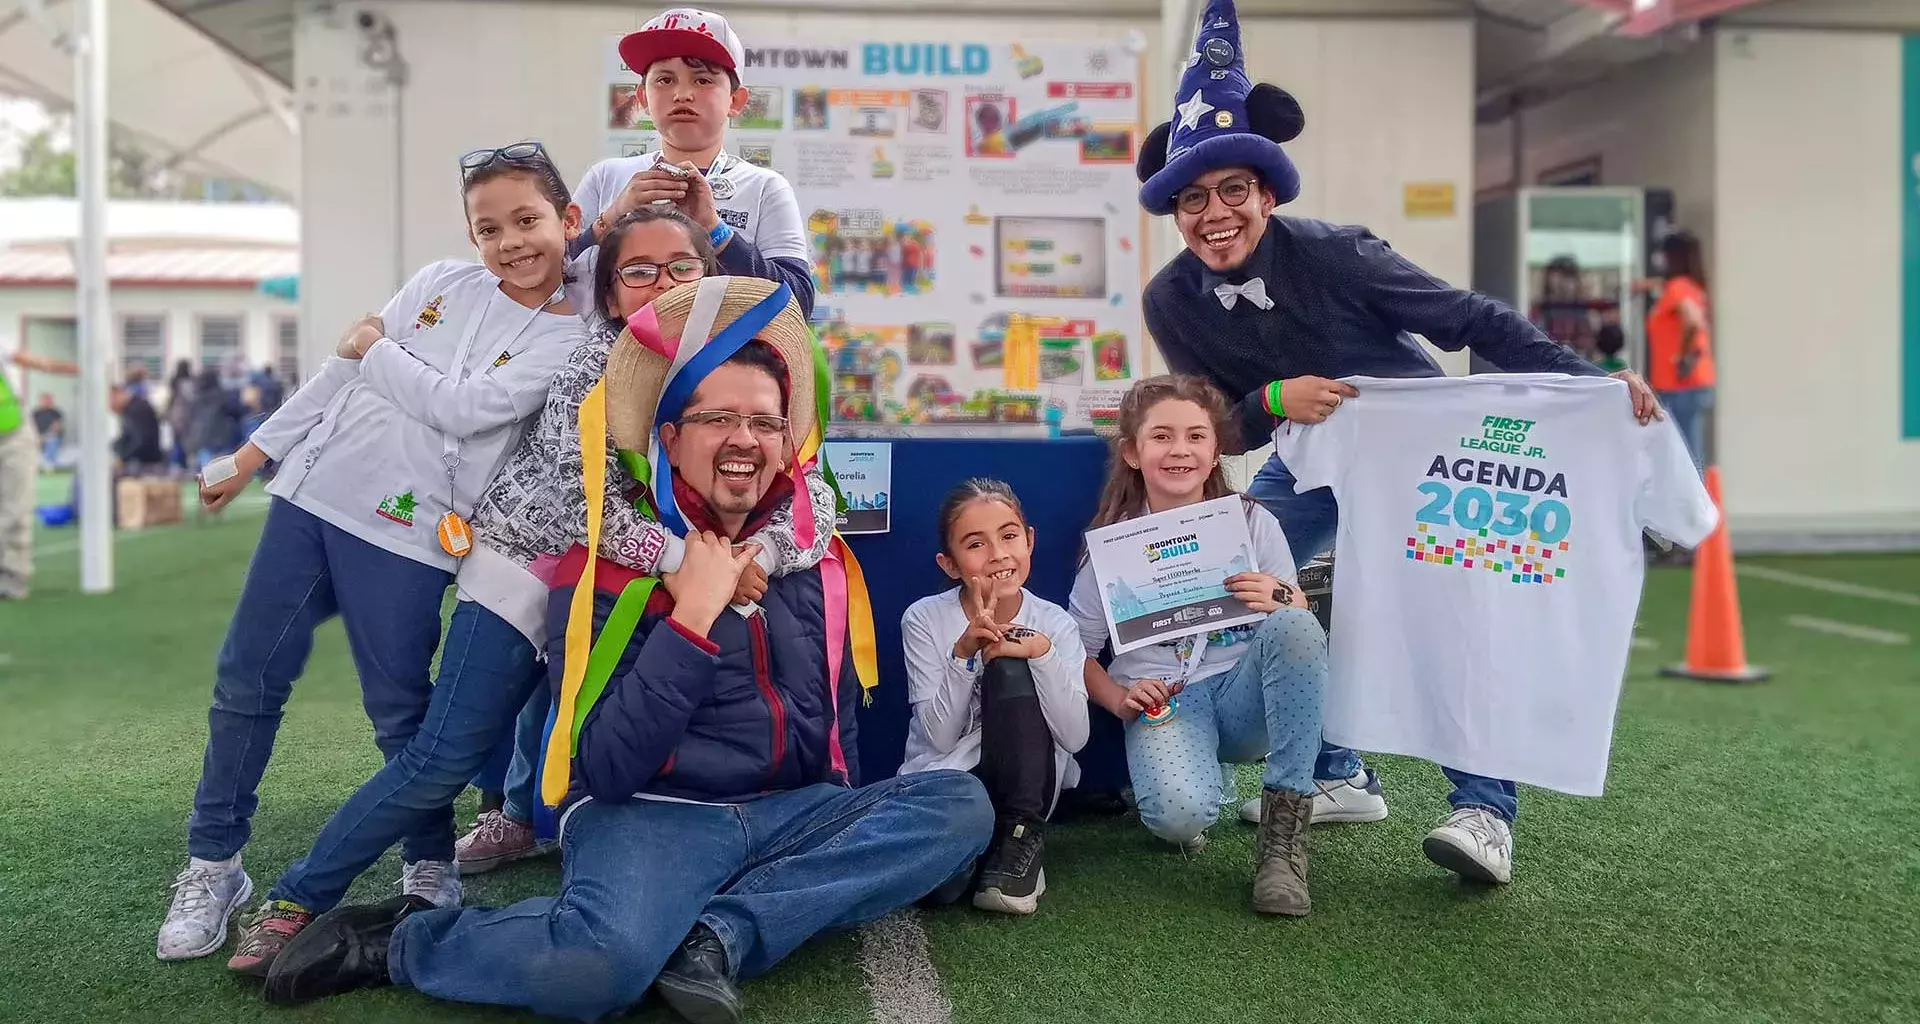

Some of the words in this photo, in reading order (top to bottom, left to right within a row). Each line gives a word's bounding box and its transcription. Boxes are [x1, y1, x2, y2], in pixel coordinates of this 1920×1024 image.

[744, 48, 849, 68] MTOWN
[862, 44, 989, 75] BUILD
[1482, 416, 1536, 432] FIRST
[1484, 428, 1526, 443] LEGO
[1460, 437, 1520, 456] LEAGUE
[1524, 446, 1546, 459] JR.
[1426, 455, 1568, 498] AGENDA
[379, 501, 414, 521] PLANTA
[1415, 481, 1571, 544] 2030
[621, 539, 639, 557] SO
[630, 528, 663, 573] SWEET!
[1149, 533, 1197, 550] BOOMTOWN
[1160, 541, 1199, 560] BUILD
[1152, 618, 1172, 628] FIRST
